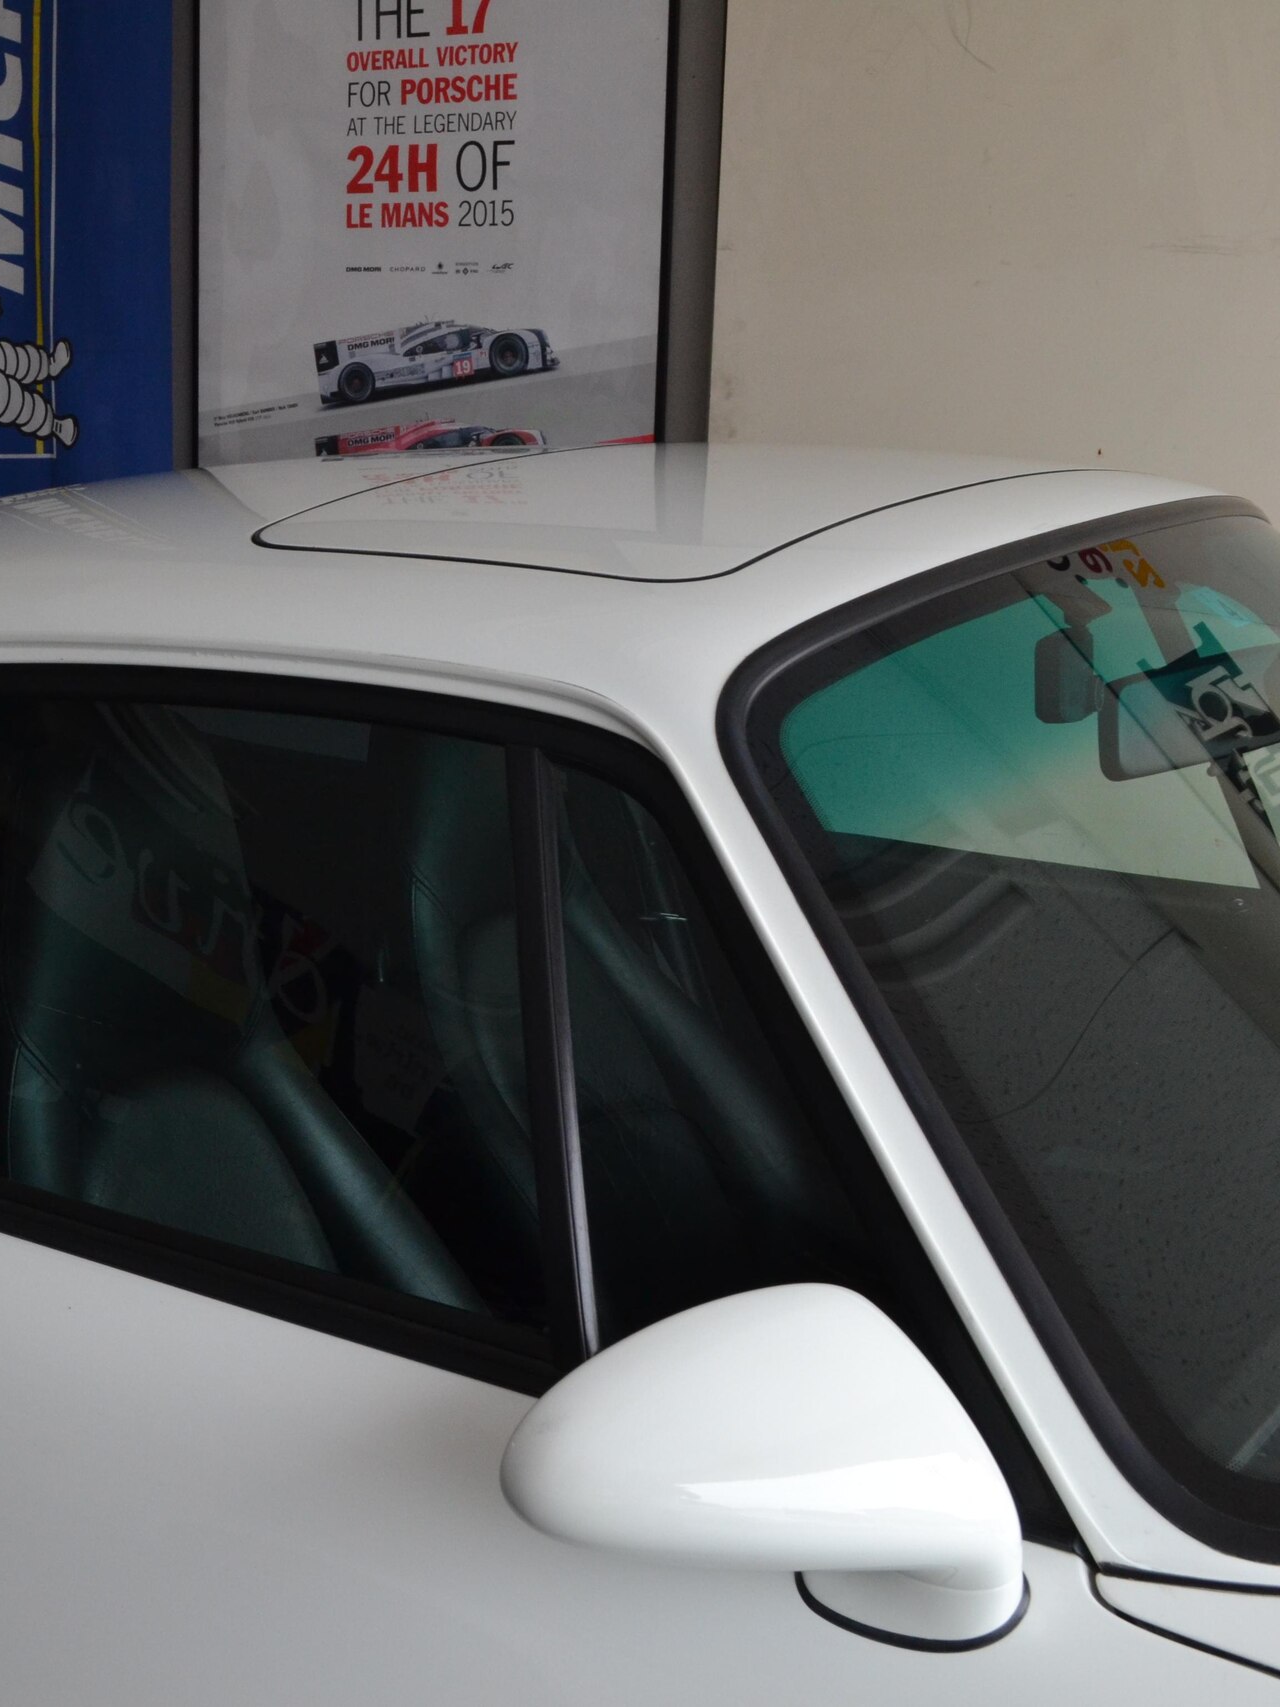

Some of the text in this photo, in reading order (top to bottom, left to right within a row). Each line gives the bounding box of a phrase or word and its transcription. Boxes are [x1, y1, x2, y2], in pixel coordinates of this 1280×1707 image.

[357, 0, 491, 42] THE 17
[346, 41, 519, 73] OVERALL VICTORY
[347, 73, 518, 108] FOR PORSCHE
[346, 110, 517, 137] AT THE LEGENDARY
[346, 139, 516, 195] 24H OF
[346, 199, 515, 229] LE MANS 2015
[347, 336, 395, 351] DMG MORI
[455, 357, 471, 376] 19
